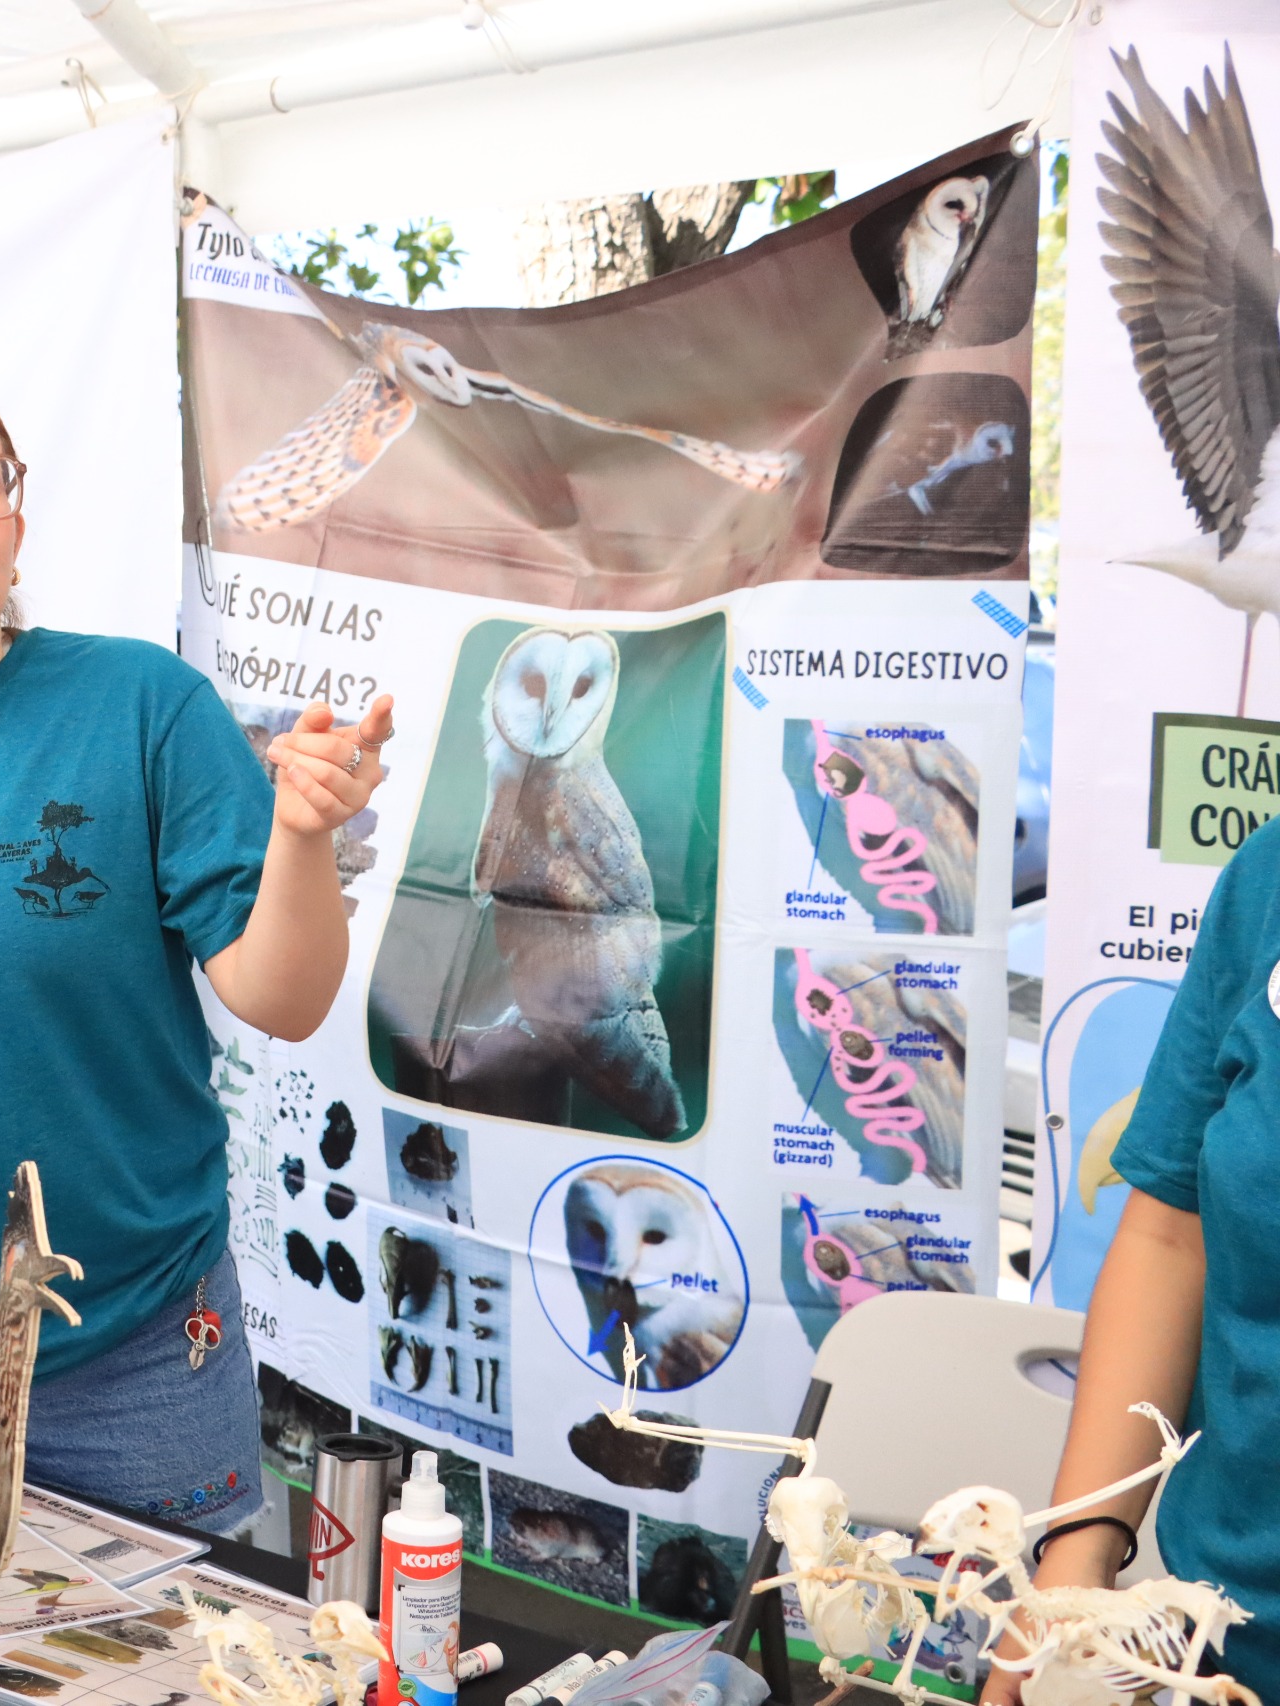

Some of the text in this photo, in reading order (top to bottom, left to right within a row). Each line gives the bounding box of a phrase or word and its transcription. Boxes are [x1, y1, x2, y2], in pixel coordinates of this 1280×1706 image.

[254, 272, 270, 292] DE
[215, 573, 383, 641] UÉ SON LAS
[746, 649, 1008, 680] SISTEMA DIGESTIVO
[865, 726, 945, 742] esophagus
[1201, 741, 1280, 795] CRÁ
[785, 890, 847, 905] glandular
[786, 907, 845, 921] stomach
[1129, 905, 1202, 934] El pi
[894, 960, 960, 975] glandular
[895, 977, 958, 990] stomach
[896, 1031, 938, 1044] pellet
[888, 1045, 944, 1062] forming
[773, 1122, 834, 1137] muscular
[774, 1137, 835, 1151] stomach
[773, 1151, 833, 1168] (gizzard)
[865, 1208, 941, 1224] esophagus
[906, 1235, 971, 1250] glandular
[907, 1250, 969, 1264] stomach
[671, 1271, 718, 1293] pellet
[48, 1500, 63, 1508] de
[62, 1505, 94, 1520] patas
[194, 1573, 288, 1608] Tipos de picos
[60, 1616, 78, 1624] de
[81, 1608, 125, 1619] Tipos
[14, 1618, 55, 1631] picos
